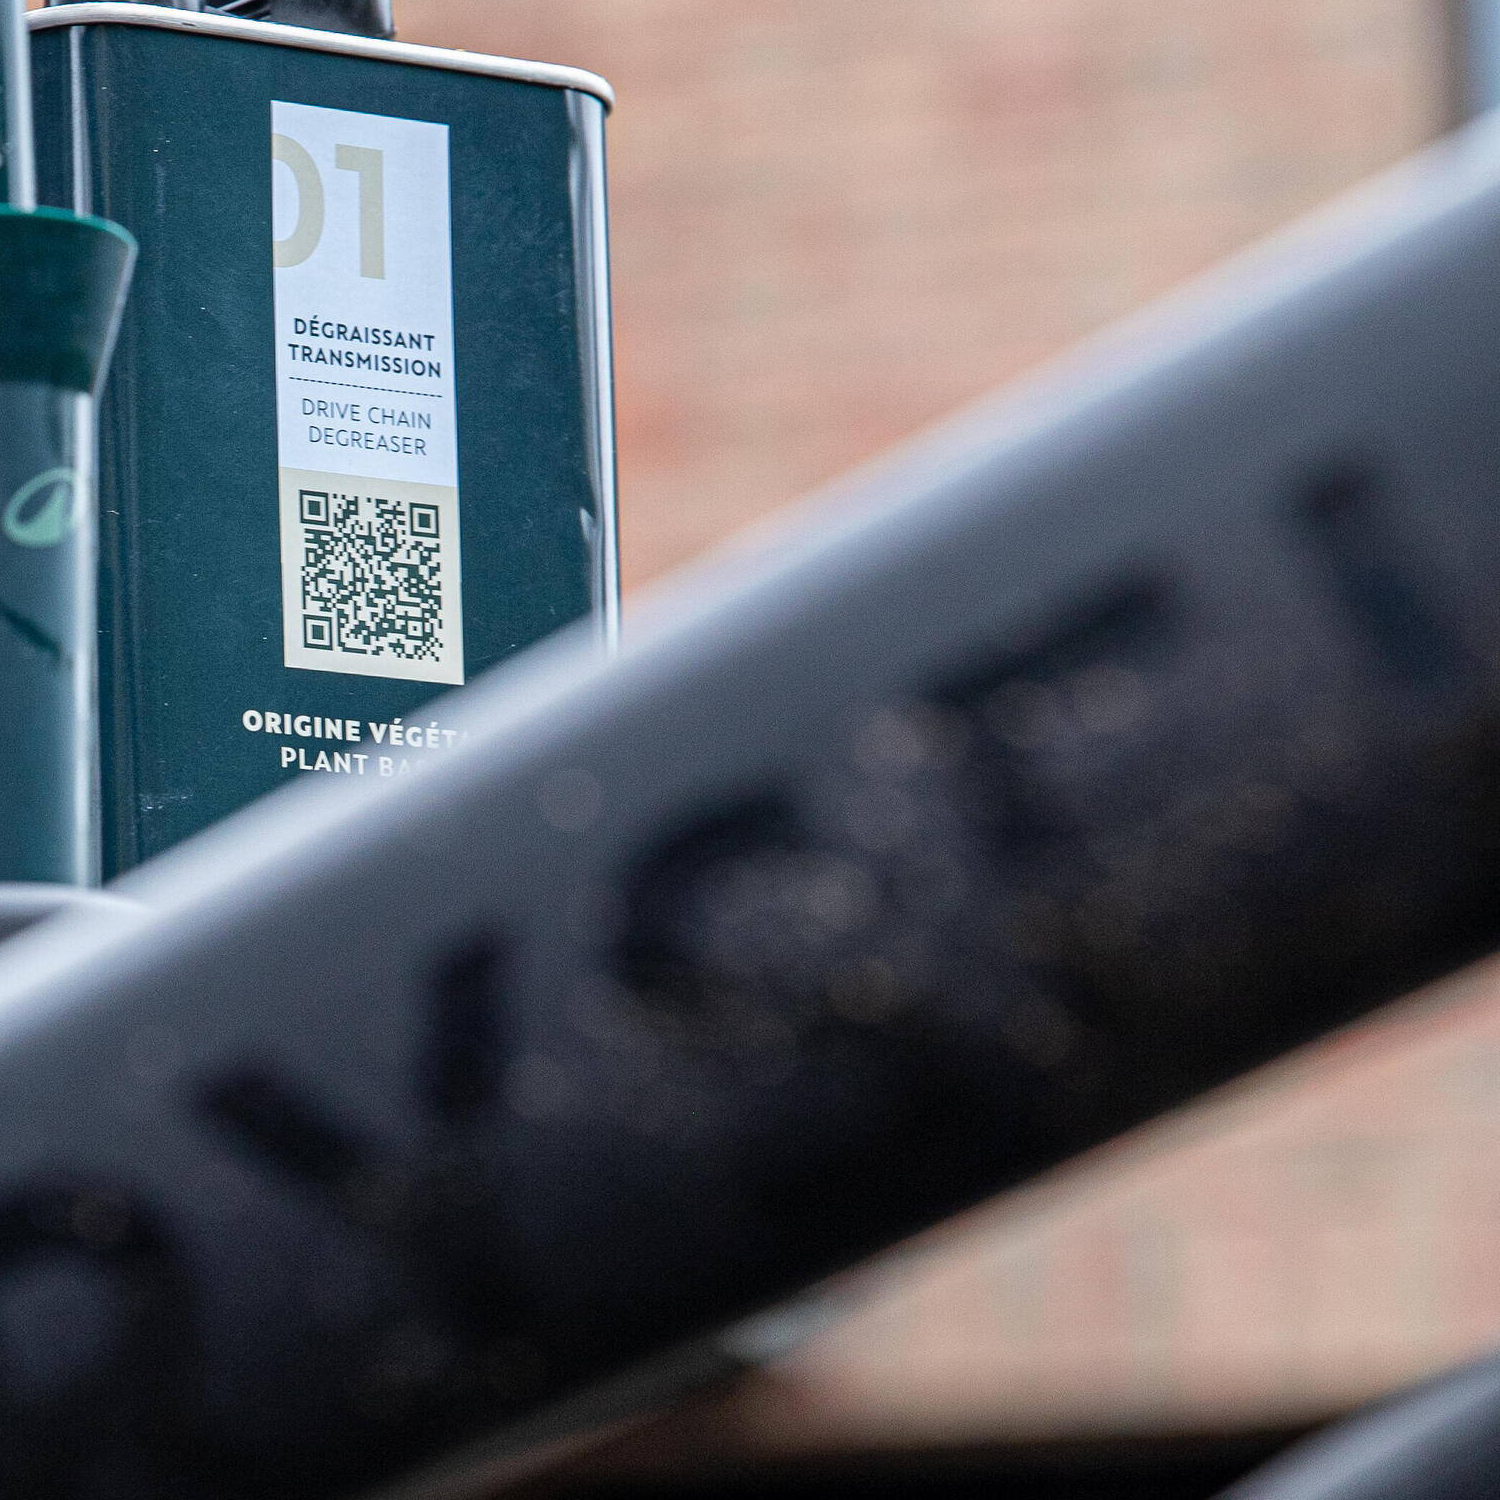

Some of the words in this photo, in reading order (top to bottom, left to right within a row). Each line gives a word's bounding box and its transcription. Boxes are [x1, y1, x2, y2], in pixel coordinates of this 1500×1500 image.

[294, 316, 435, 351] DÉGRAISSANT
[288, 344, 441, 378] TRANSMISSION
[302, 398, 360, 423] DRIVE
[367, 407, 432, 430] CHAIN
[308, 426, 427, 456] DEGREASER
[242, 710, 361, 742] ORIGINE
[281, 747, 369, 775] PLANT
